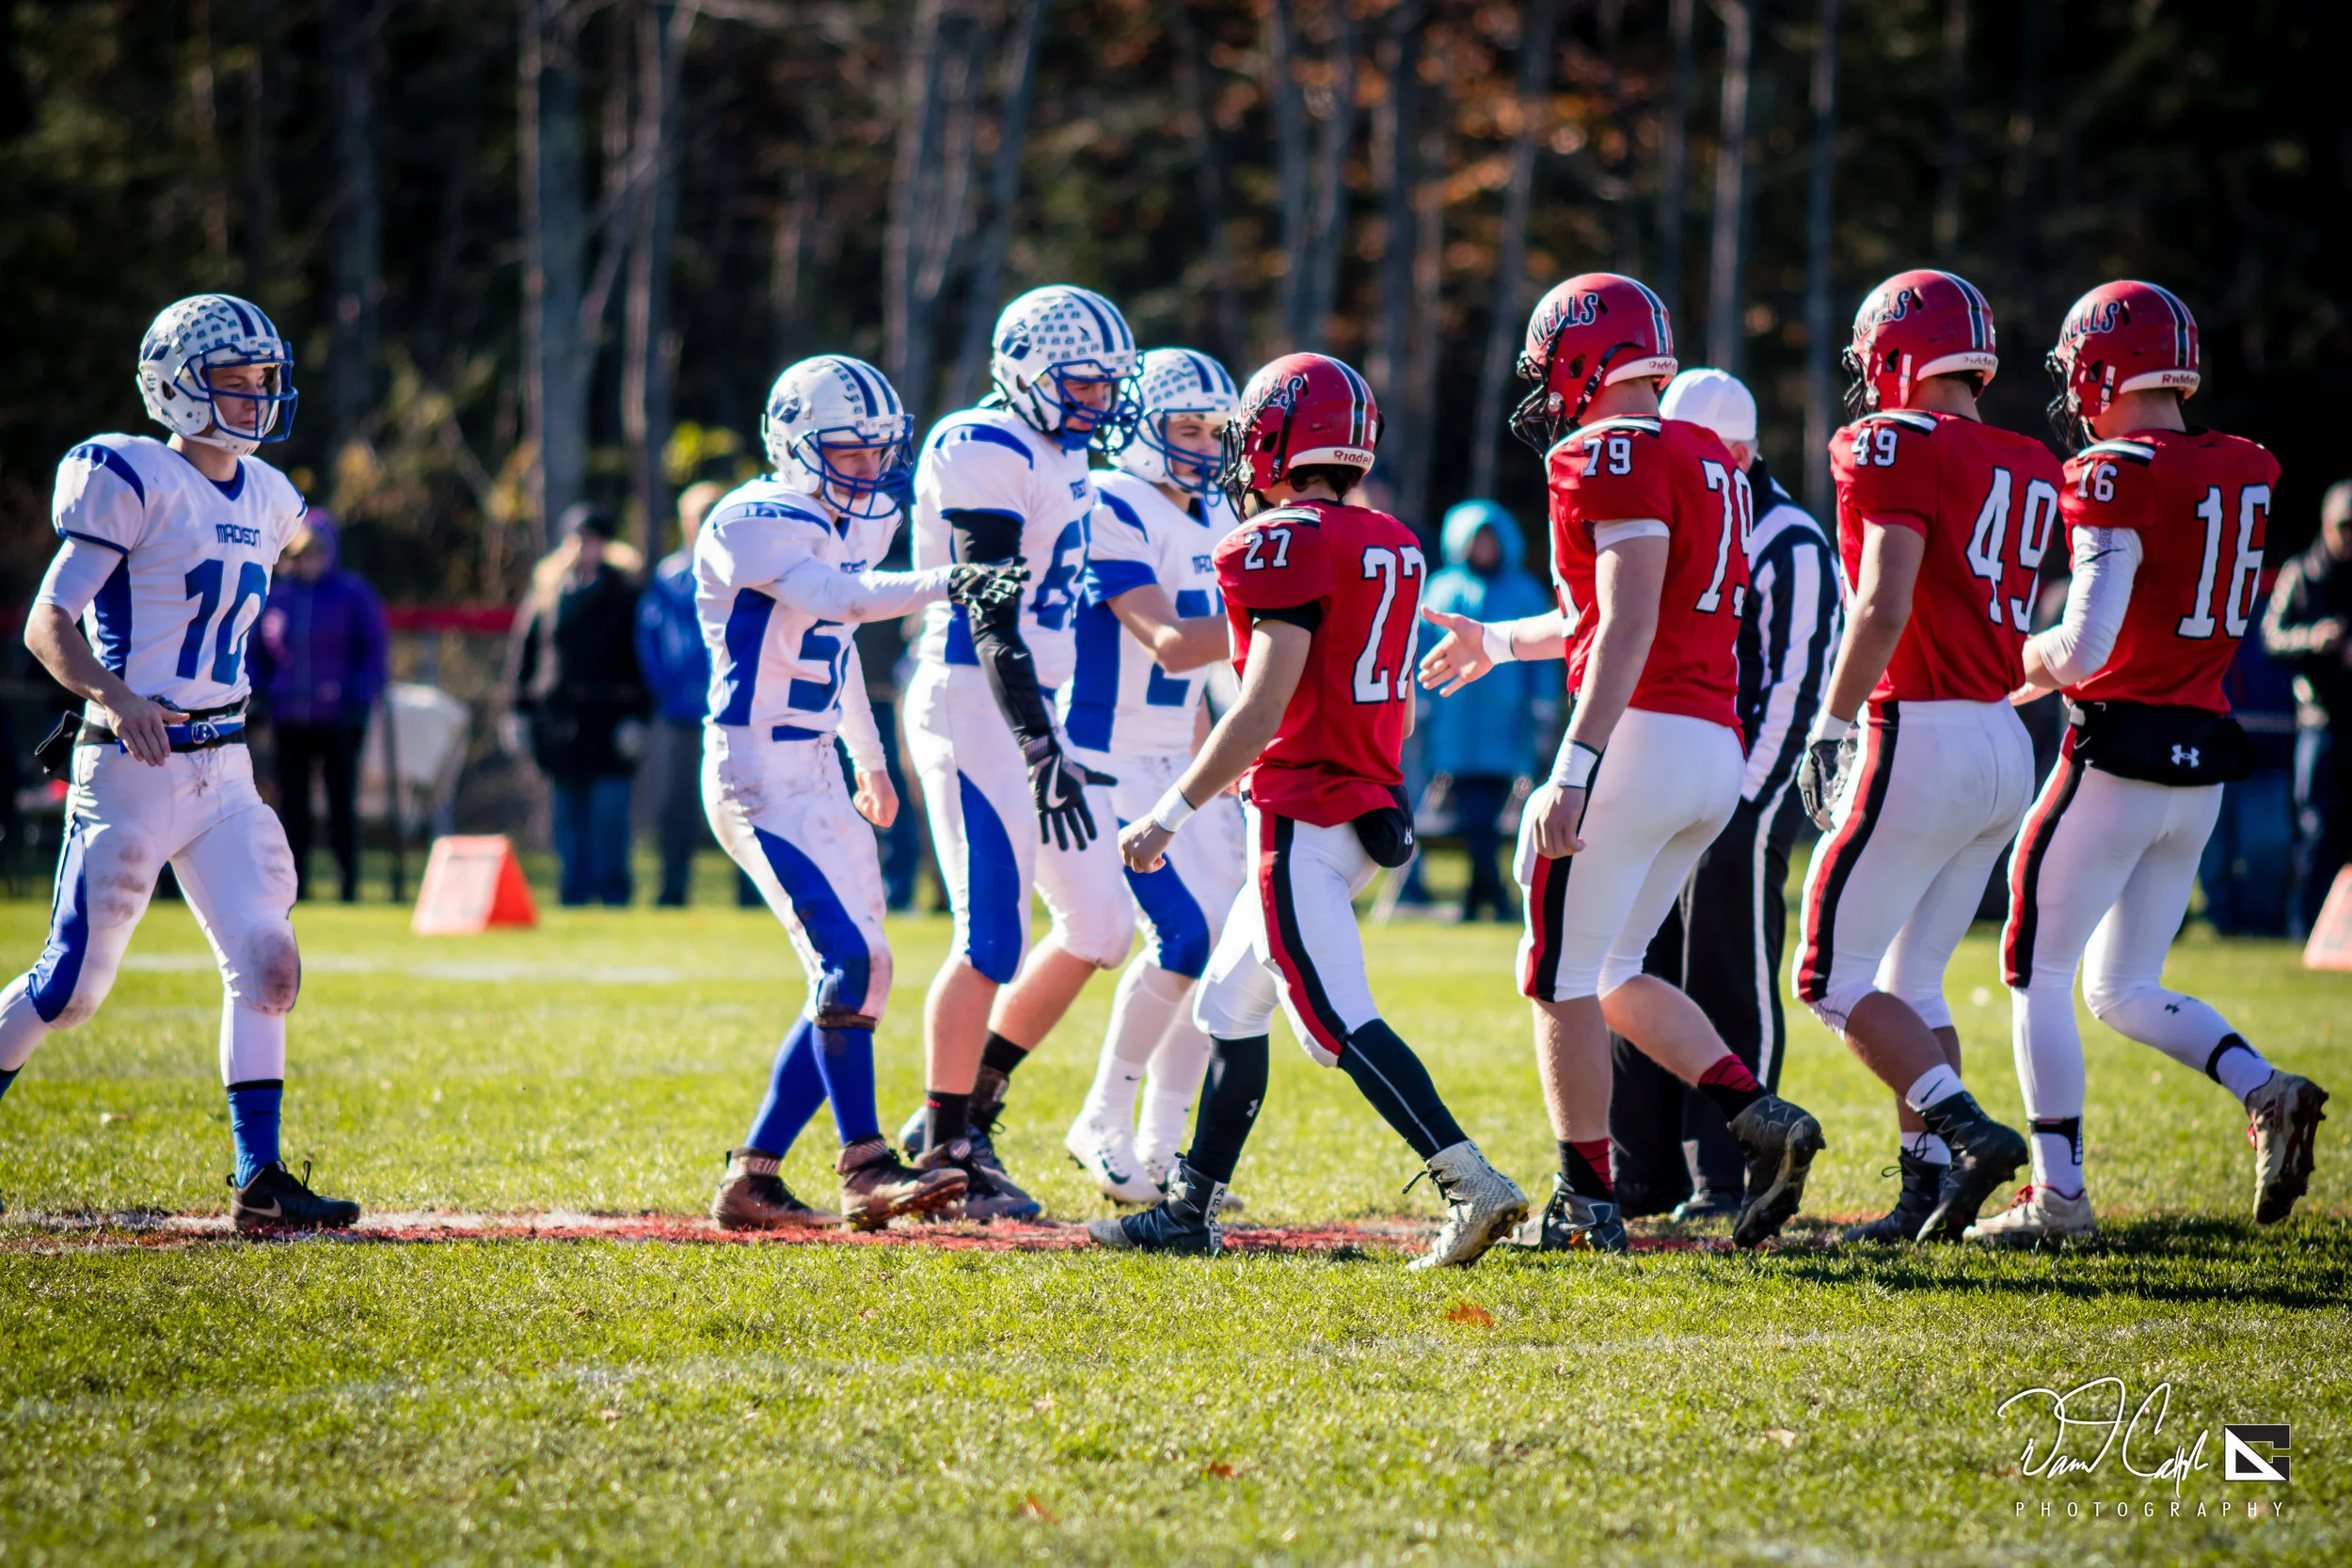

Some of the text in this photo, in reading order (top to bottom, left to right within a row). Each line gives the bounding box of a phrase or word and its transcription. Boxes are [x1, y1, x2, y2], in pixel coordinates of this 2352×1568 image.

[1531, 293, 1598, 347] WELLS
[1581, 436, 1633, 477] 79
[1851, 426, 1899, 467] 49
[2076, 460, 2118, 502] 16
[215, 523, 262, 549] MADISON
[1243, 528, 1293, 571] 27
[1694, 457, 1754, 620] 79
[1963, 465, 2058, 635] 49
[2173, 483, 2270, 641] 16
[176, 558, 267, 686] 10
[1351, 545, 1427, 705] 27
[787, 618, 850, 714] 5
